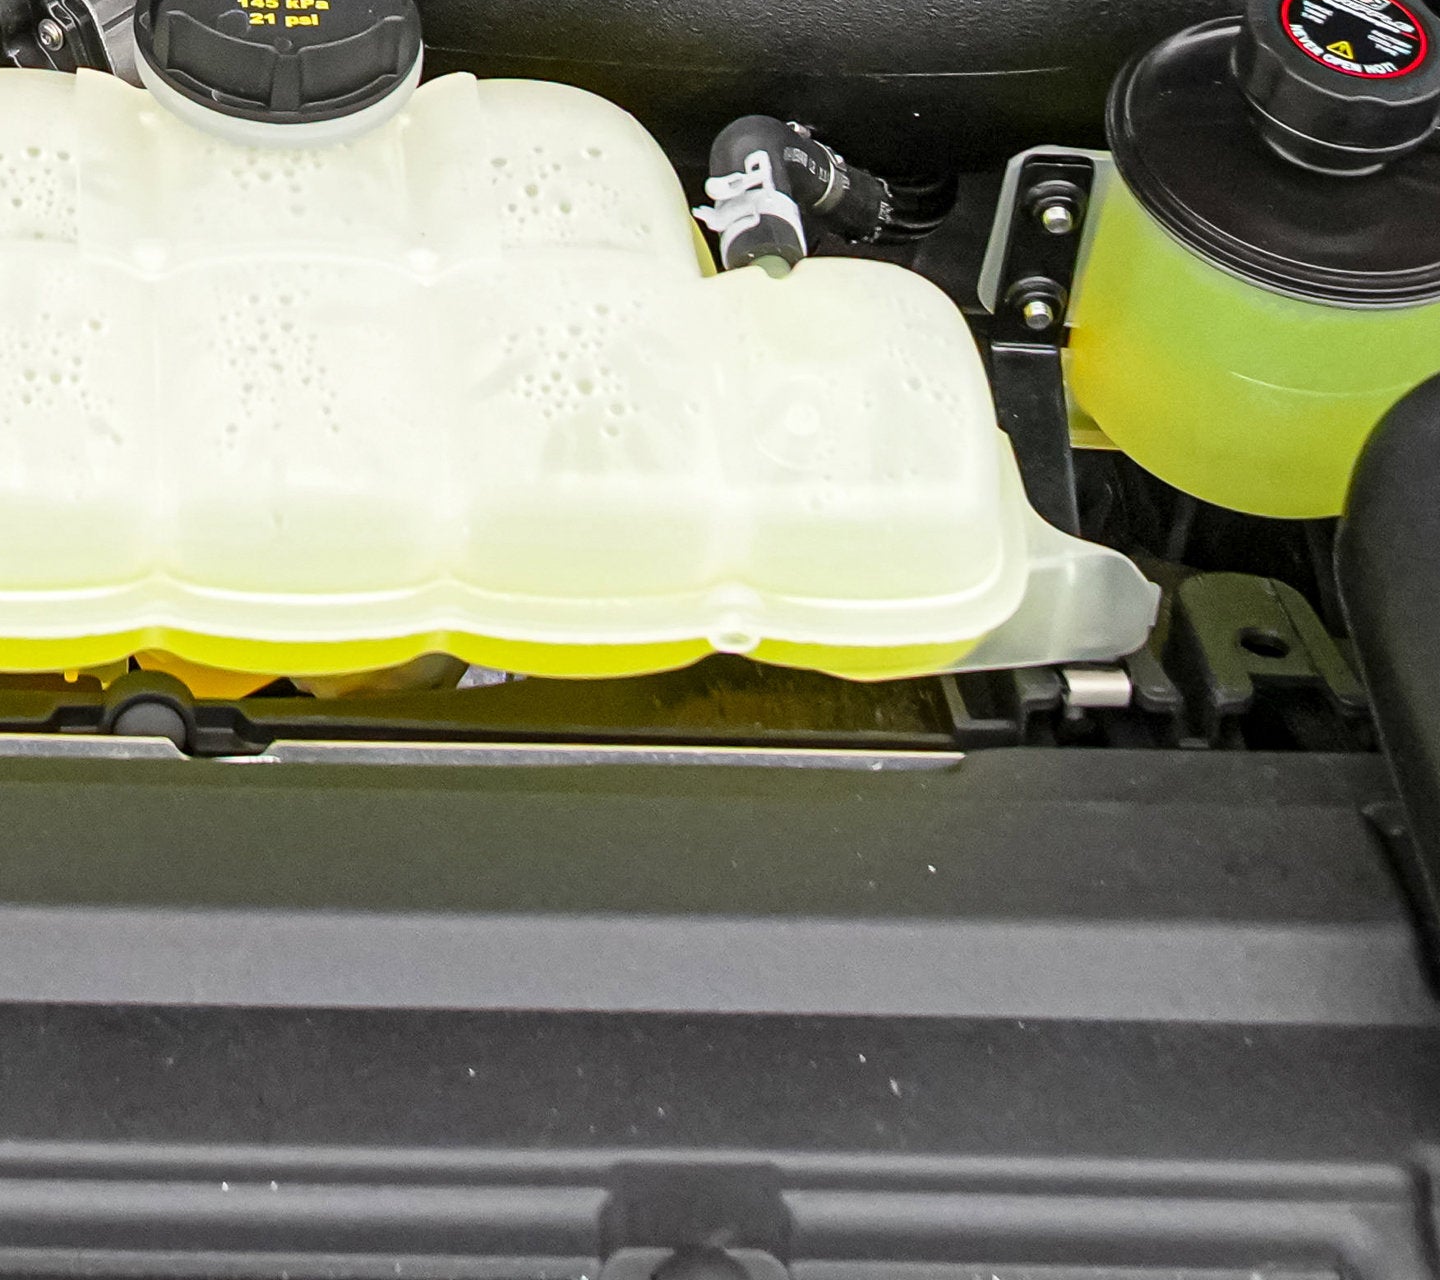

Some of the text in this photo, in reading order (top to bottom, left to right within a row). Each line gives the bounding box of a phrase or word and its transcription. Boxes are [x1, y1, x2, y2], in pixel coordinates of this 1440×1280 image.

[248, 12, 320, 28] 21 psi
[1289, 23, 1325, 57] NEVER
[1322, 53, 1364, 74] OPEN
